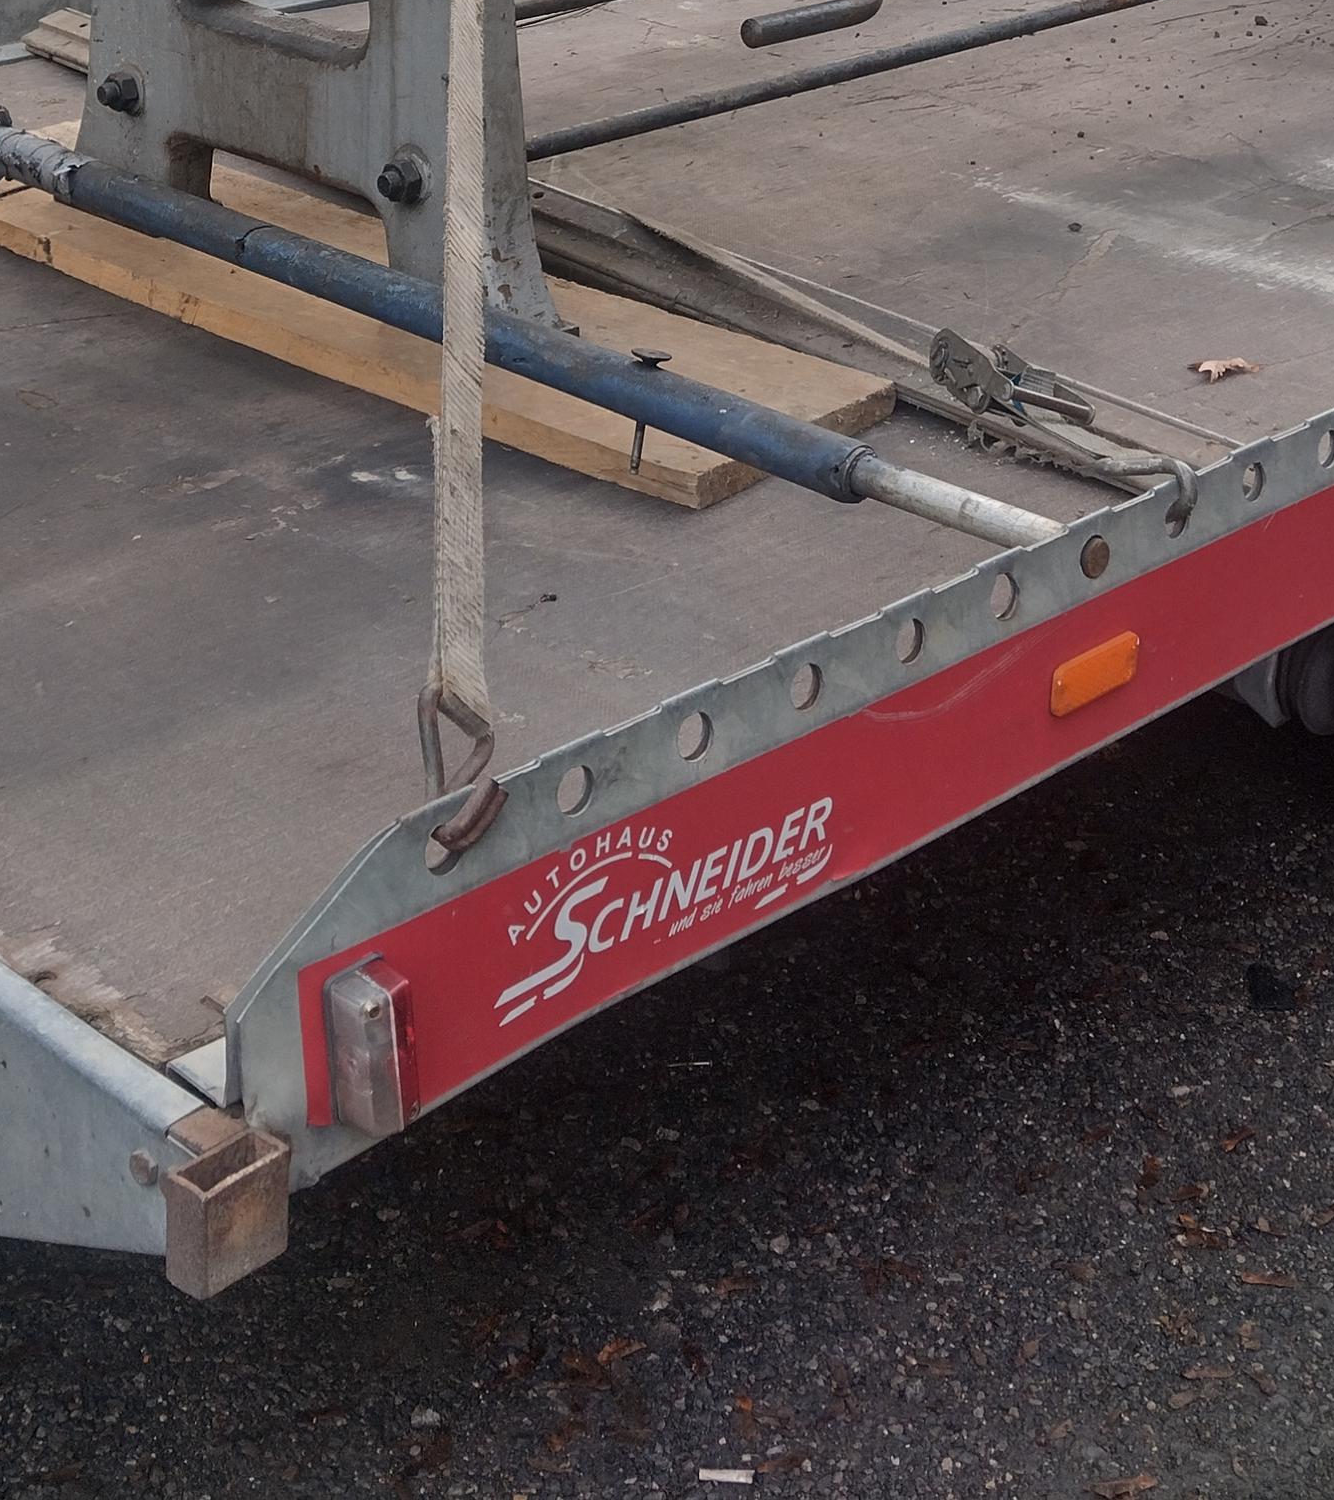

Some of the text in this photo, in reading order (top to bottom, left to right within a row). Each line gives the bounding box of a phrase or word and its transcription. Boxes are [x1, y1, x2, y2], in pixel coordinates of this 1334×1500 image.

[493, 797, 833, 1009] SCHNEIDER
[507, 826, 673, 947] AUTOHAUS
[668, 846, 827, 937] und sie fahren besser
